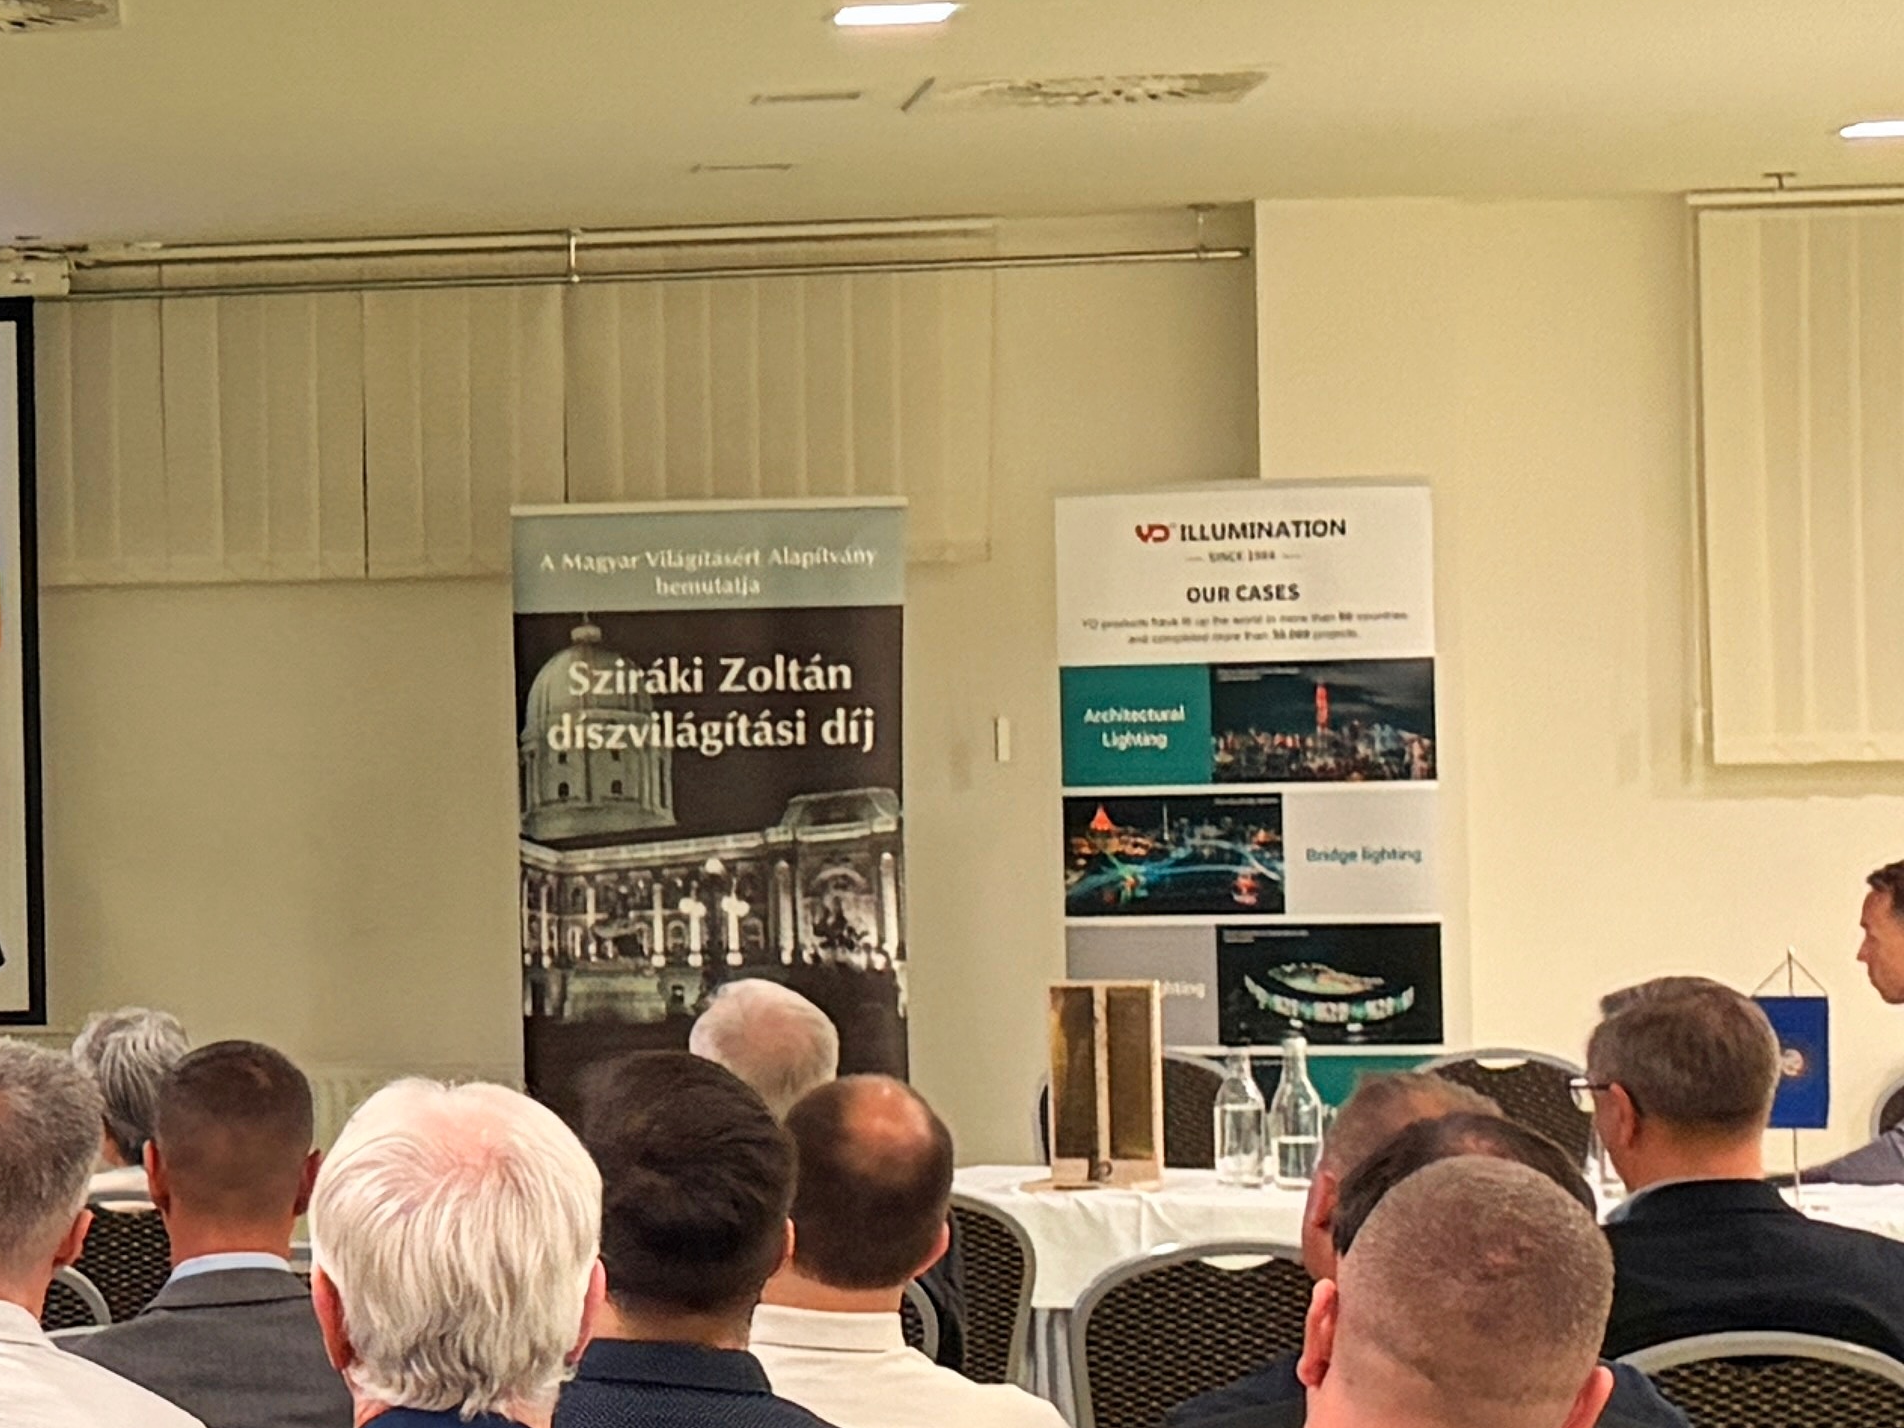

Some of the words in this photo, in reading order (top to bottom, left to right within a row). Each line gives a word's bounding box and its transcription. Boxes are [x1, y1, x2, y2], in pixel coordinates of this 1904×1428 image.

[1180, 519, 1346, 542] ILLUMINATION
[540, 553, 555, 570] A
[562, 552, 641, 574] Magyar
[655, 574, 761, 597] bemutatja
[1186, 586, 1230, 604] OUR
[1235, 582, 1300, 602] CASES
[568, 656, 704, 696] Sziráki
[719, 653, 853, 693] Zoltán
[1083, 703, 1186, 723] Architectural
[547, 708, 807, 757] díszvilágítási
[821, 706, 876, 753] díj
[1101, 730, 1168, 751] Lighting
[1305, 846, 1357, 865] Bridge
[1361, 845, 1422, 865] lighting
